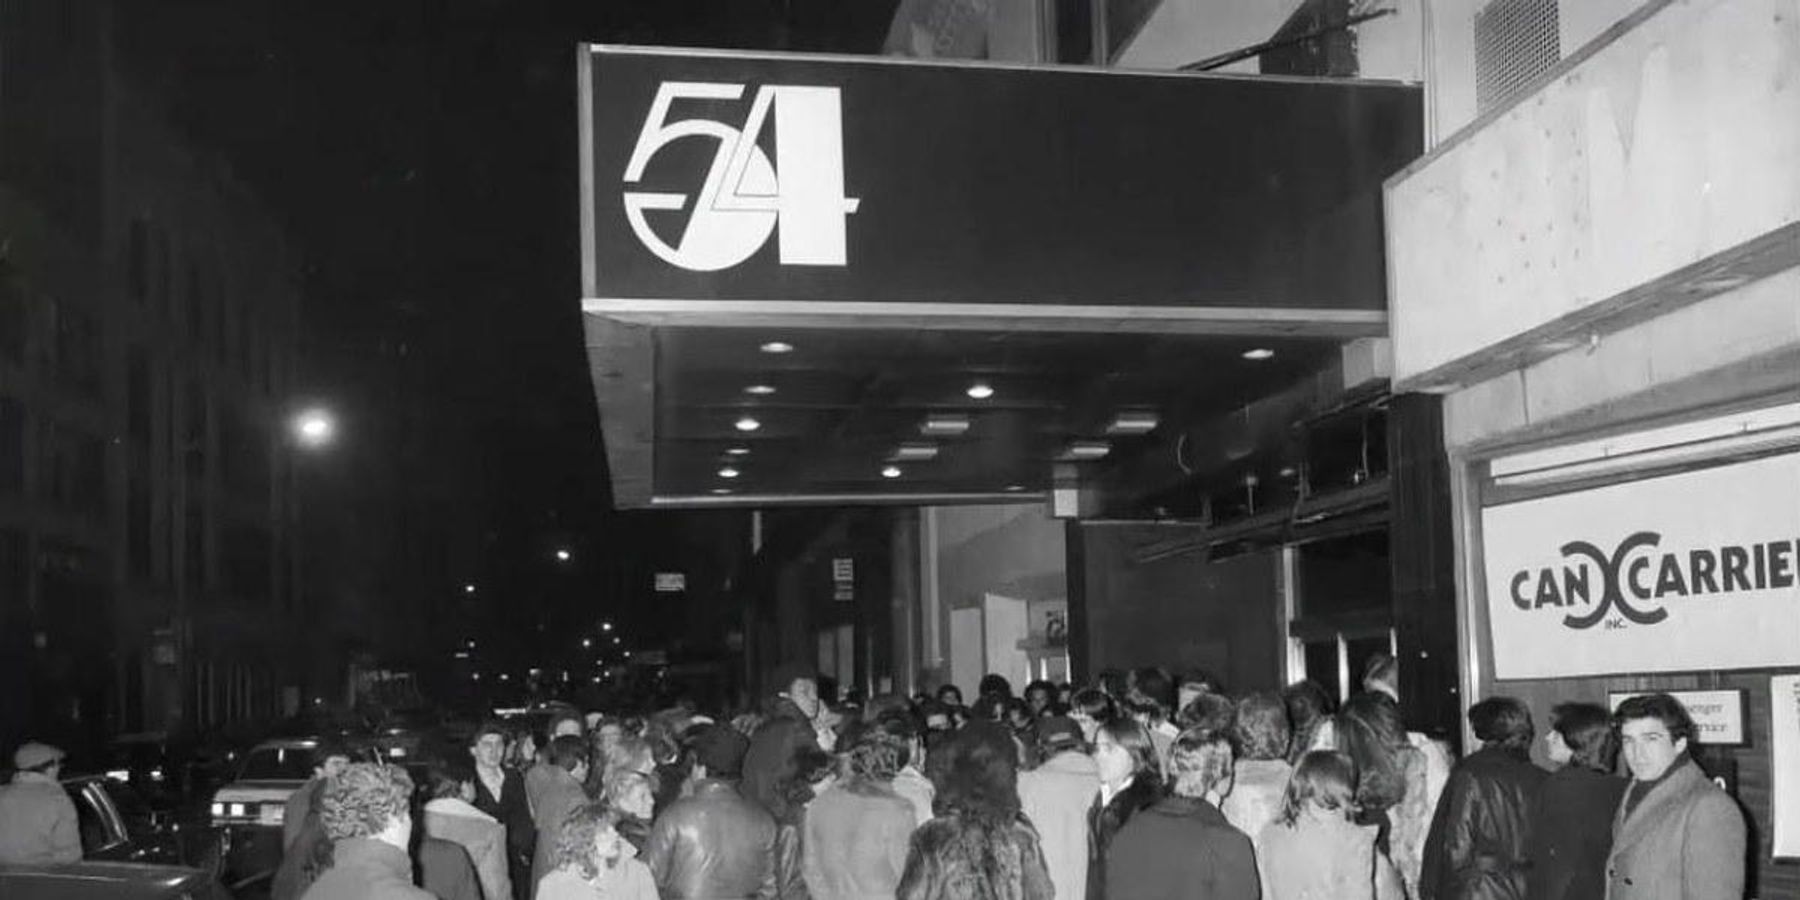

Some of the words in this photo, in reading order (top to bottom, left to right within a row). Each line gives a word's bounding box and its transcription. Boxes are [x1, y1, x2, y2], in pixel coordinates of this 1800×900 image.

[623, 81, 860, 271] 54
[1510, 563, 1591, 610] CAN
[1628, 540, 1800, 600] CARRIE
